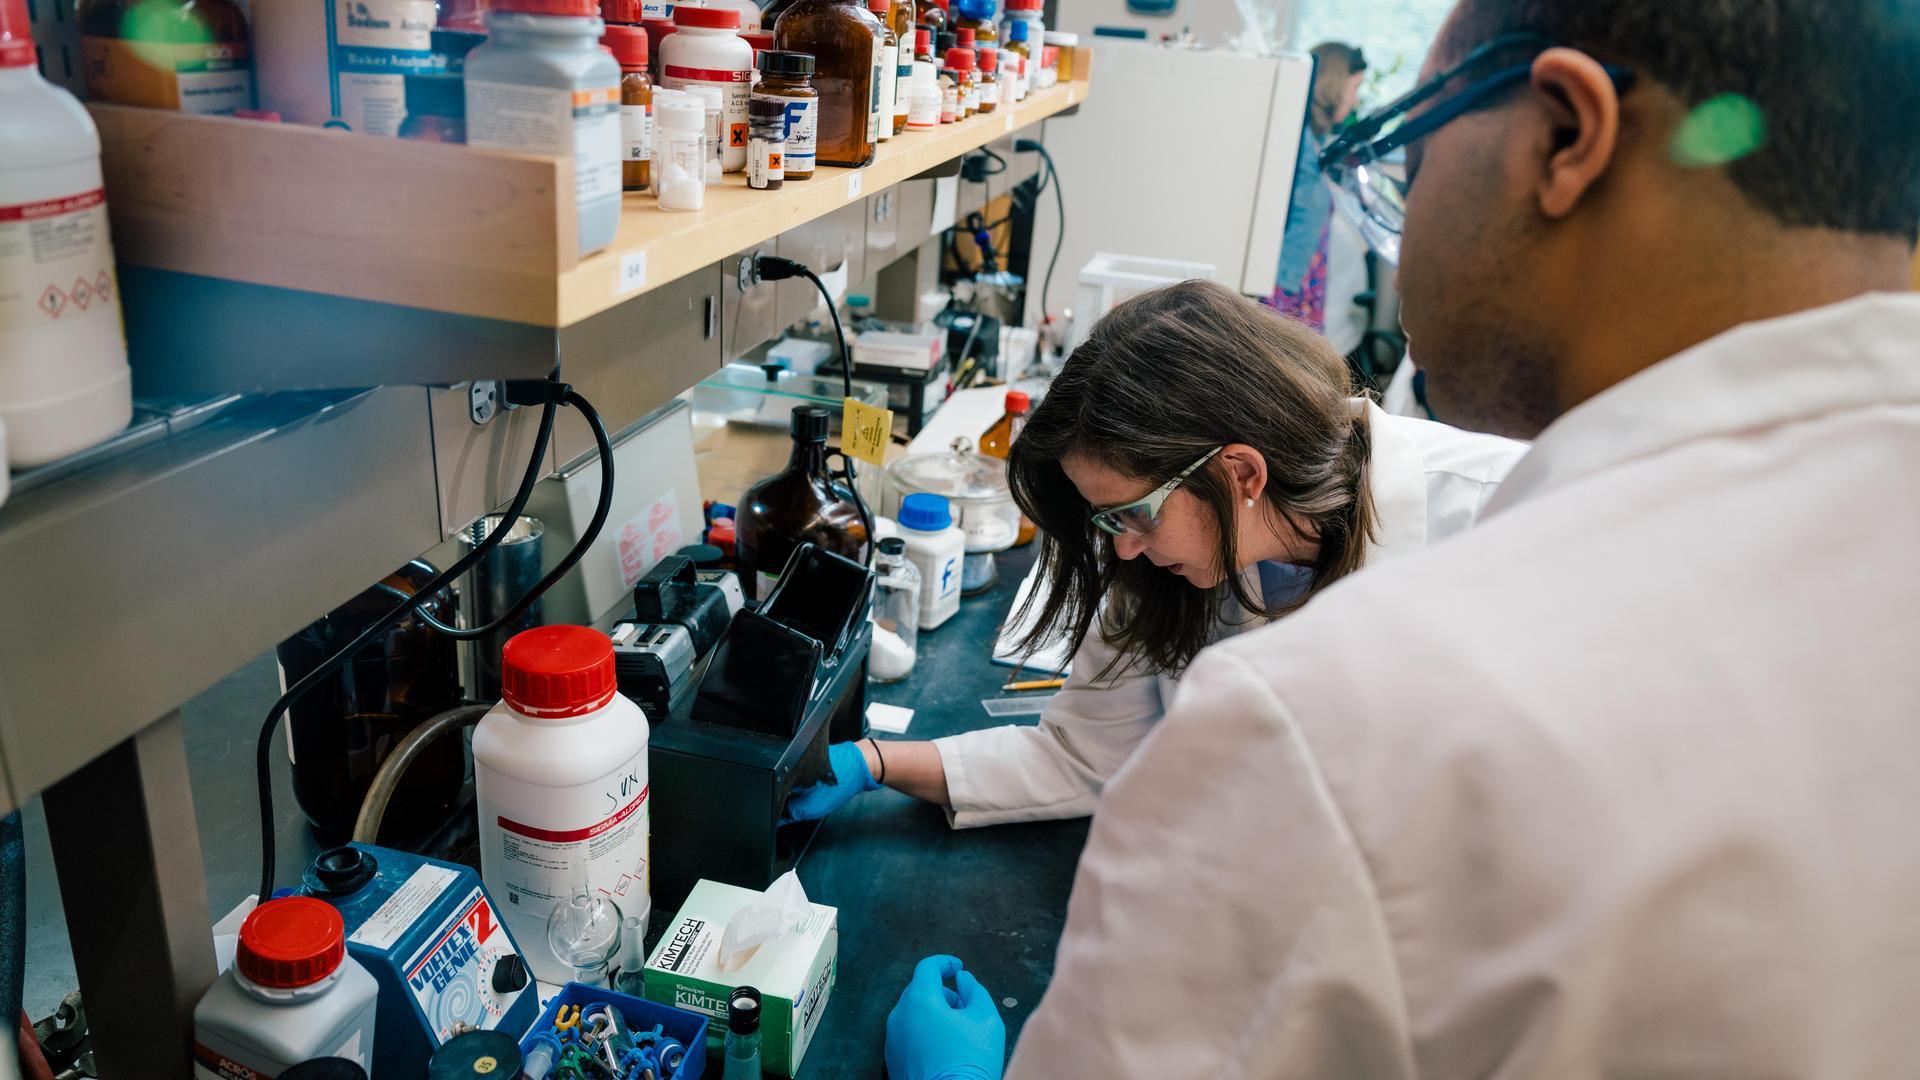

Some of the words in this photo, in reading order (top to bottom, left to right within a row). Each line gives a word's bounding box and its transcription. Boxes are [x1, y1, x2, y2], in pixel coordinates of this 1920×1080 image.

[589, 790, 647, 836] SIGMA-ALDRICH
[467, 900, 498, 946] 2
[657, 918, 698, 970] KIMTECH
[431, 935, 480, 994] GENIE
[675, 991, 729, 1013] KIMTE
[676, 983, 705, 995] Kimwipes
